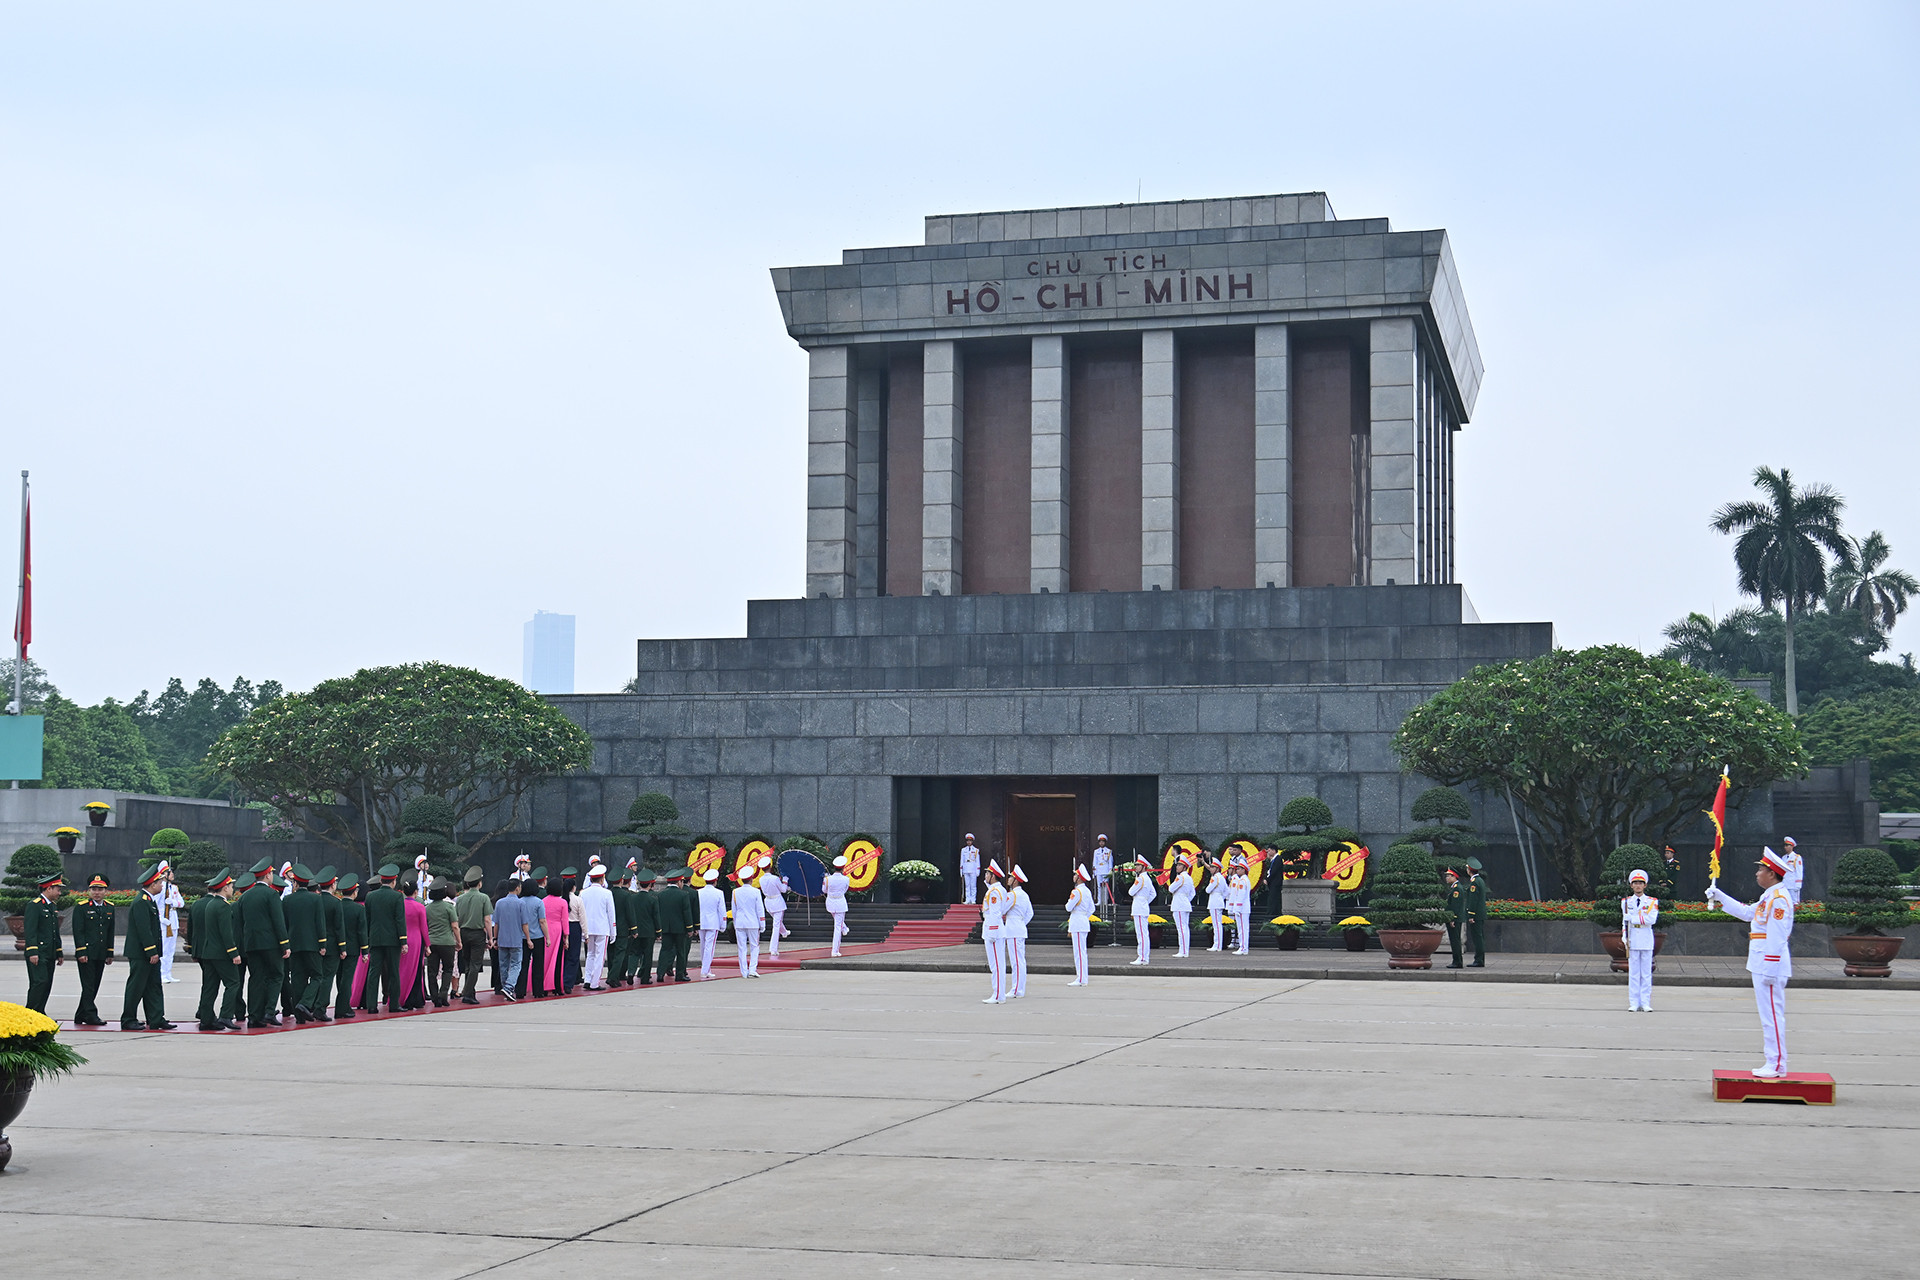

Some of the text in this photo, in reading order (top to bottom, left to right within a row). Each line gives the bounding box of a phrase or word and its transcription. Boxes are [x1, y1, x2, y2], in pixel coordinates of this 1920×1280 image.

[1027, 251, 1166, 277] CHỦ TỊCH
[947, 281, 1002, 314] HỒ
[1036, 275, 1106, 309] CHÍ
